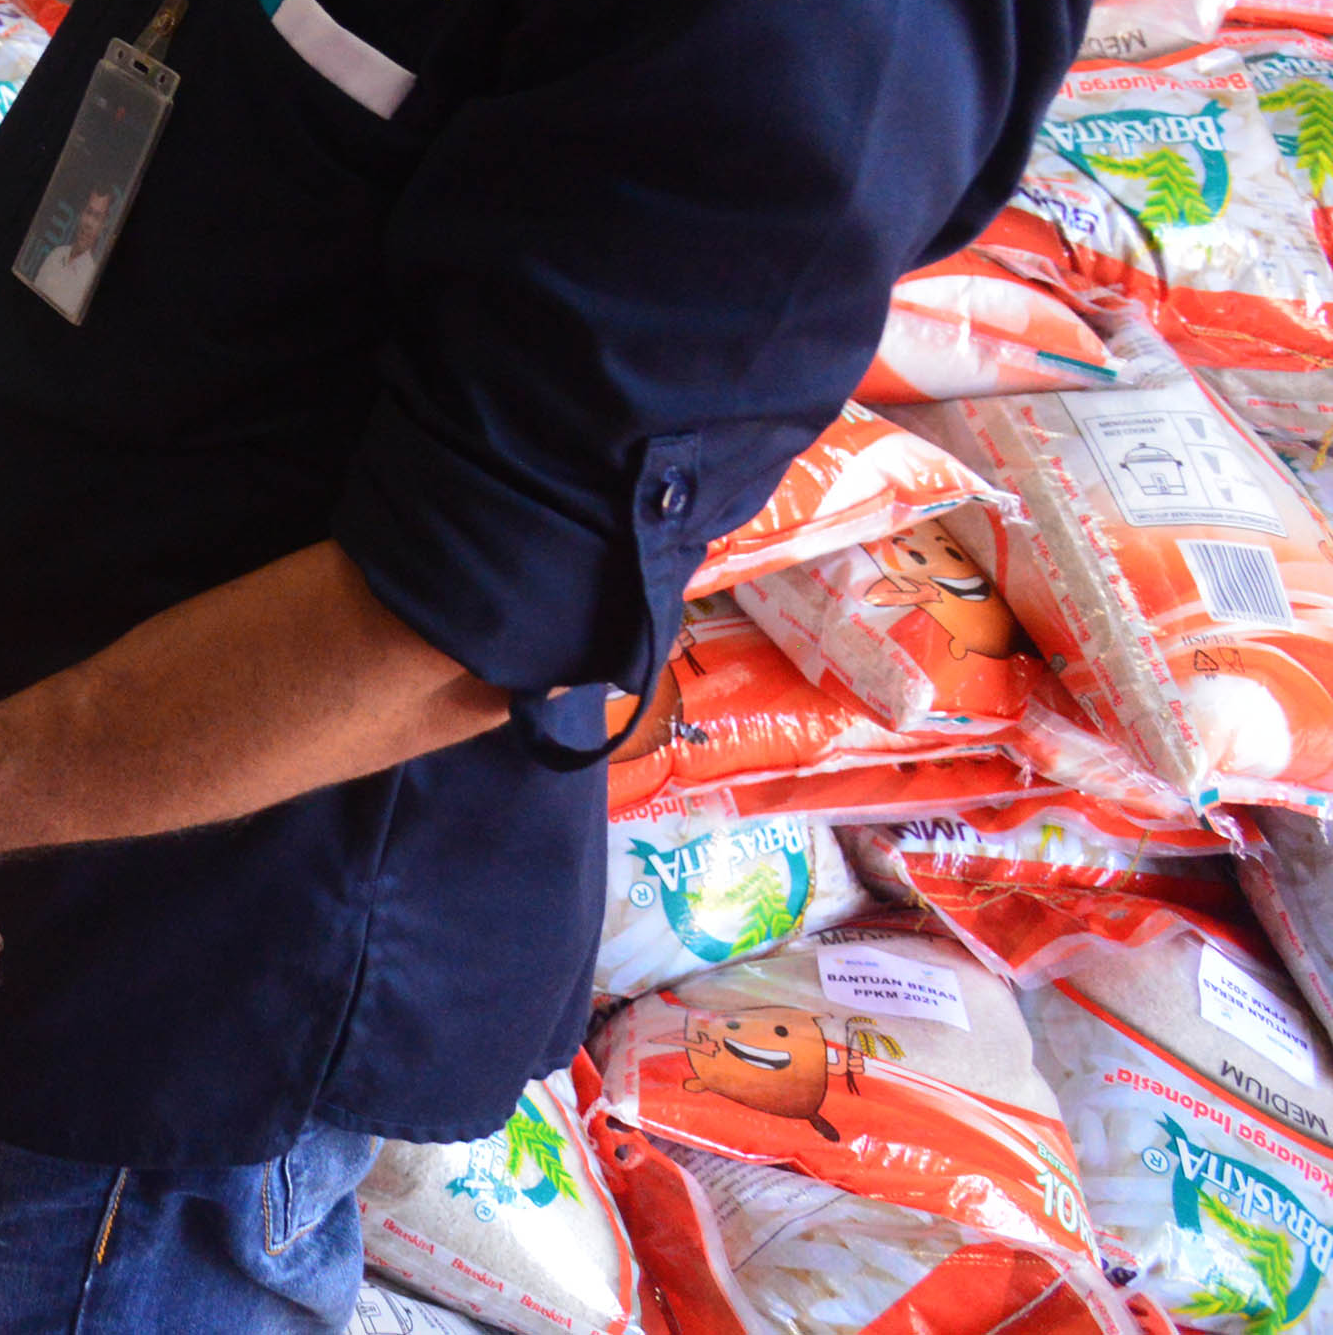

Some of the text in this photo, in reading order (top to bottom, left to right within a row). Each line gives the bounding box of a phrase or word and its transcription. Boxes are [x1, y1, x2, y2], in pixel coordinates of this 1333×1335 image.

[827, 974, 959, 1003] BANTUAN BERAS
[853, 989, 939, 1007] PPKM 2021
[1221, 976, 1248, 998] 2021
[1203, 978, 1308, 1051] BANTUAN BERAS
[1221, 1059, 1329, 1136] MEDIUM
